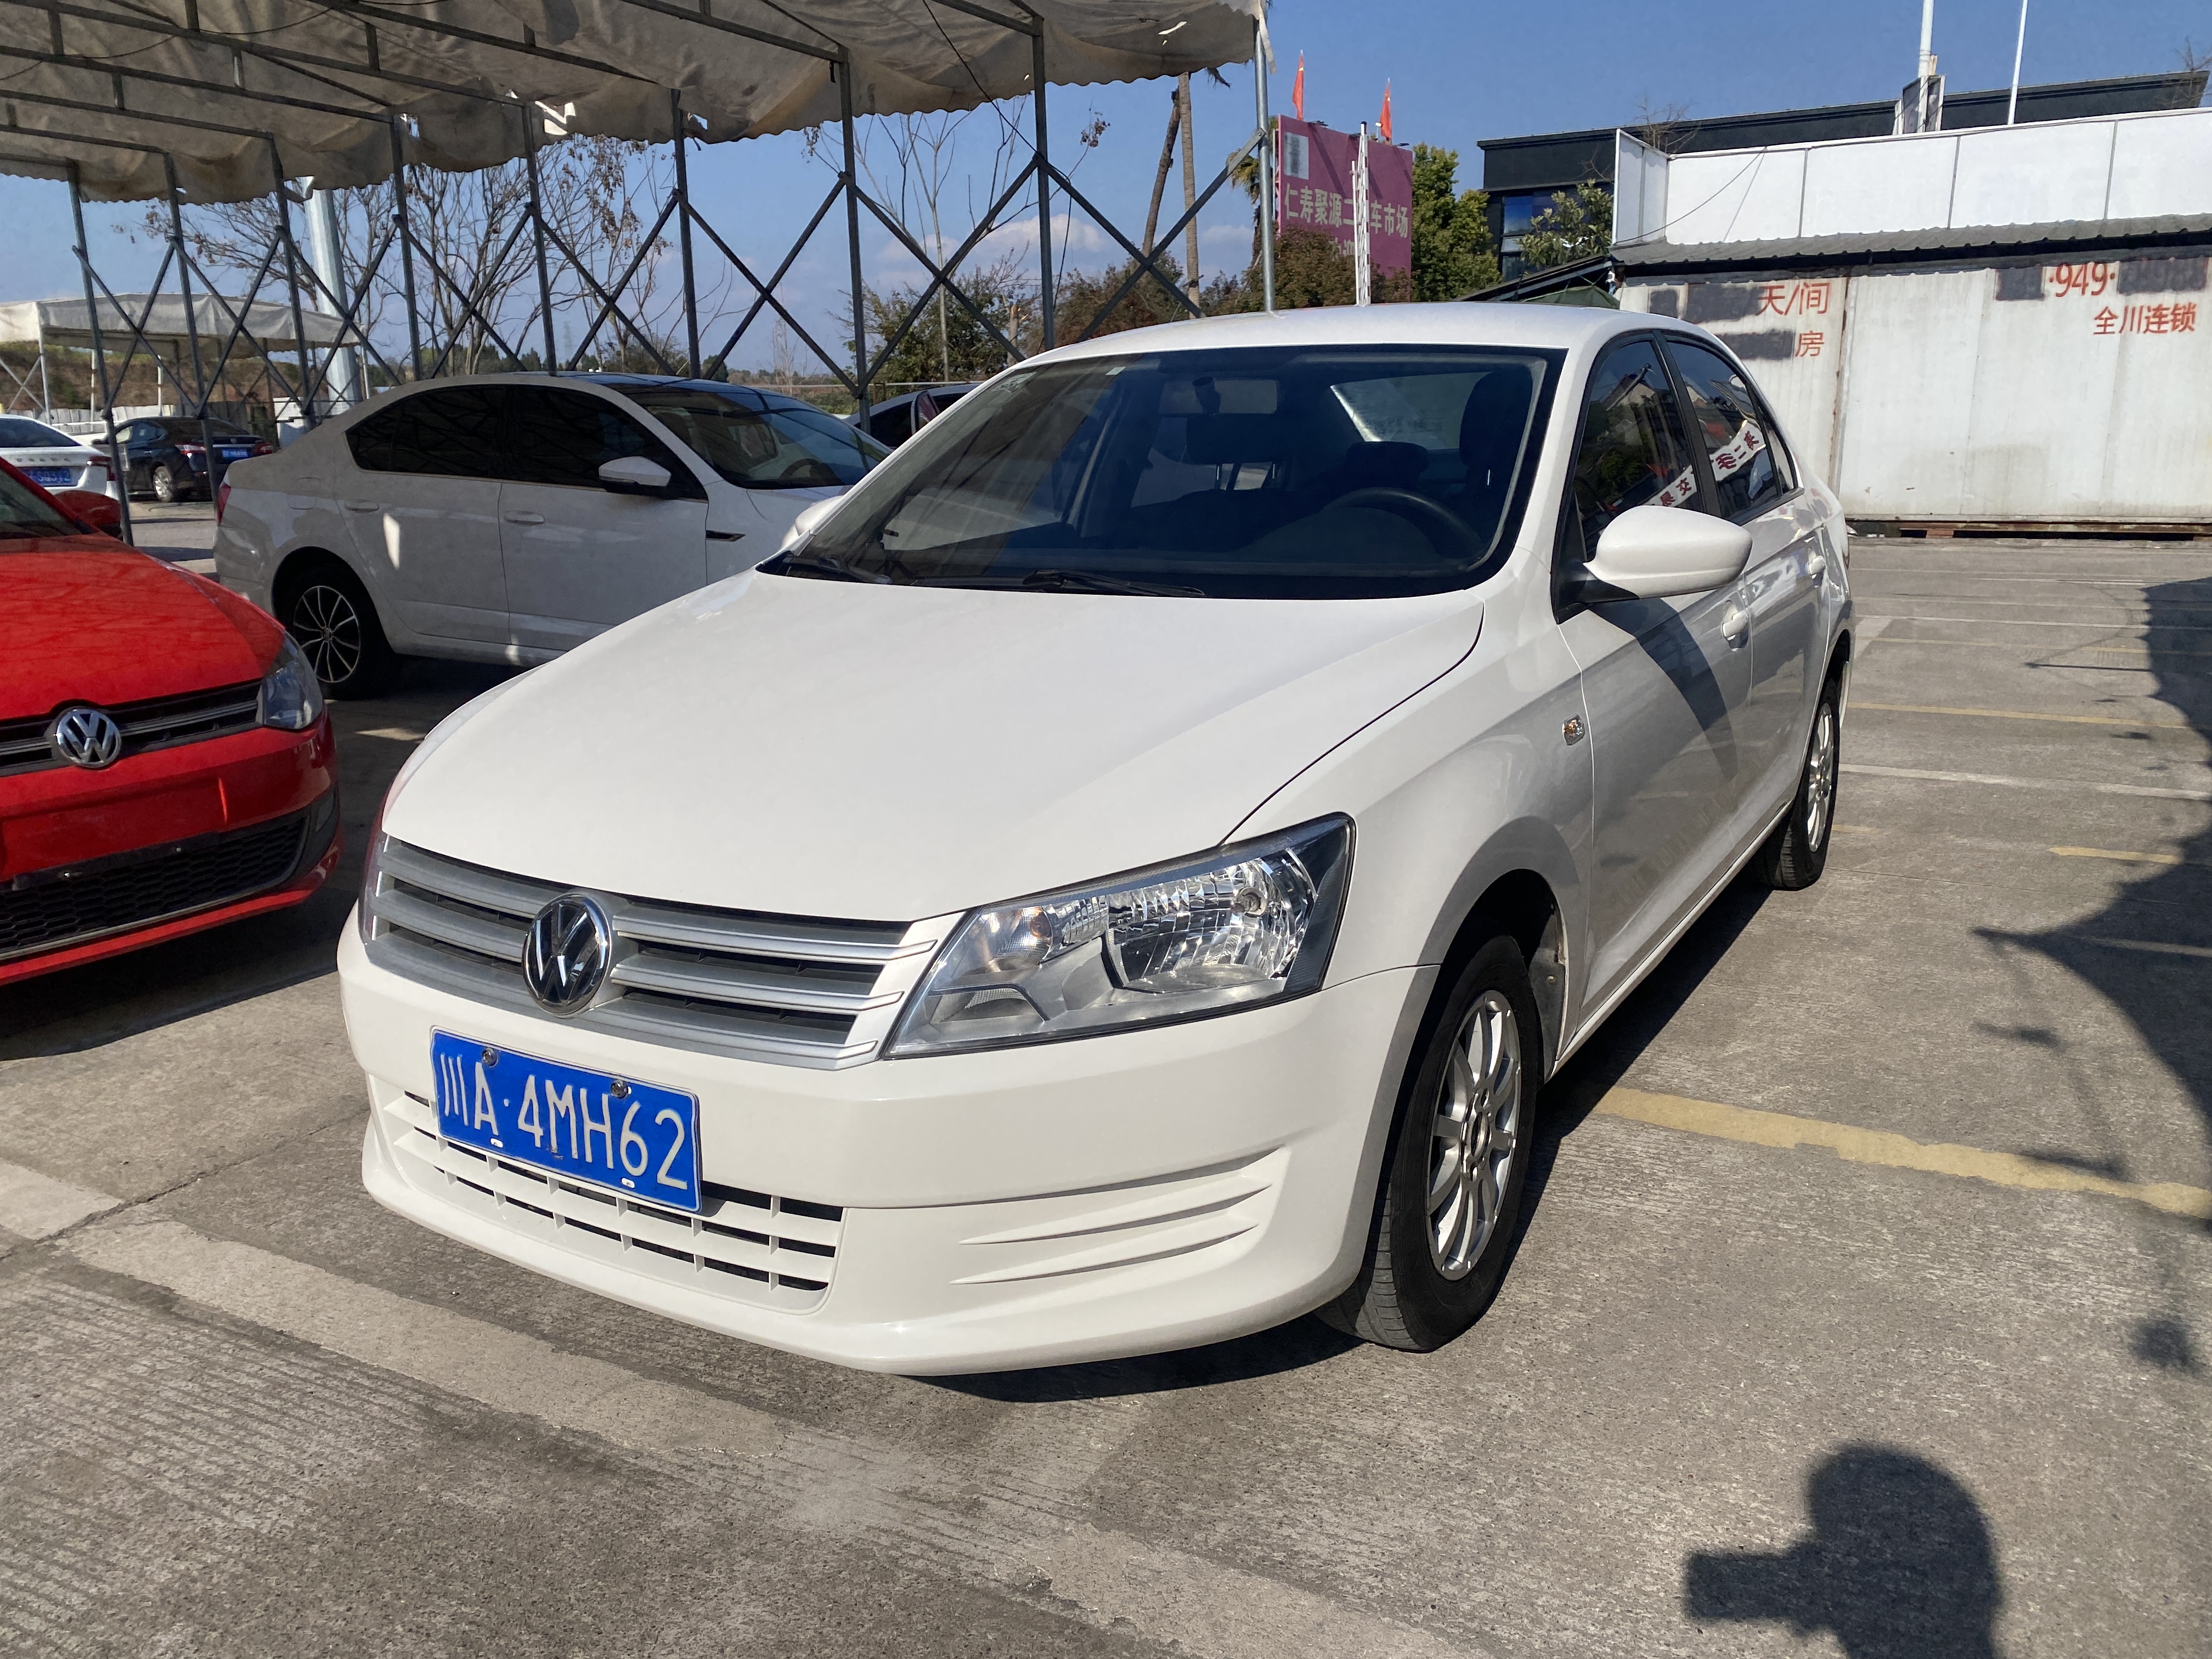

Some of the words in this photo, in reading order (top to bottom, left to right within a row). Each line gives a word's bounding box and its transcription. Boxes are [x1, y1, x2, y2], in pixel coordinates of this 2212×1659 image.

[1284, 183, 1408, 239] 仁寿聚源二车市场
[2093, 302, 2197, 335] 全川连锁
[1795, 330, 1824, 357] 房
[440, 1052, 689, 1190] 川A·4MH62
